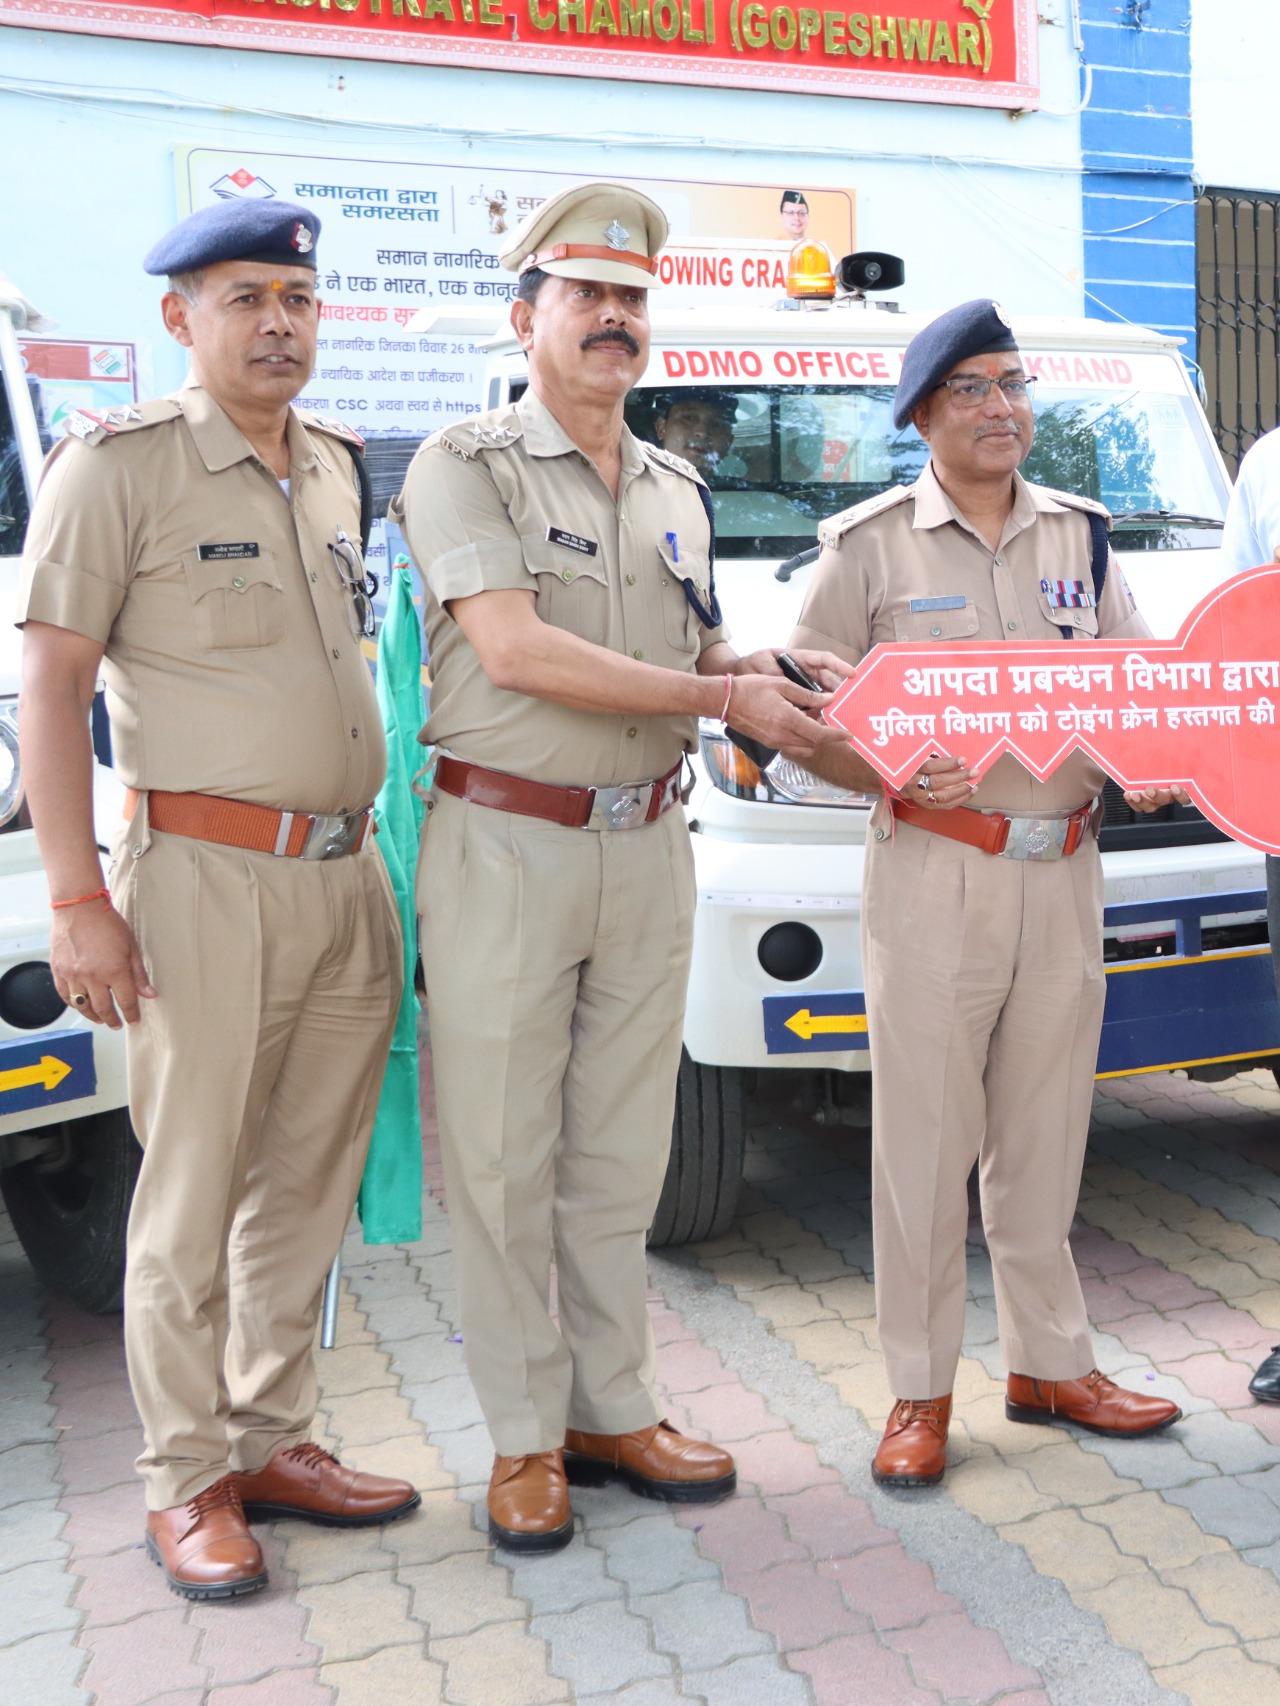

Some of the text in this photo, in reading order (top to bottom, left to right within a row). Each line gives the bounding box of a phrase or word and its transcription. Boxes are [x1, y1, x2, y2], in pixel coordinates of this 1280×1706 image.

[528, 0, 716, 44] CHAMOLI
[729, 0, 993, 74] (GOPESHWAR)
[294, 183, 438, 205] समानता द्वारा
[341, 204, 440, 222] समरसता
[376, 248, 500, 269] समान नागरिक
[325, 270, 341, 291] ने
[347, 276, 378, 292] एक
[439, 280, 468, 296] एक
[654, 255, 787, 288] OWING CRA
[331, 336, 376, 352] नागरिक
[379, 337, 416, 352] जिनका
[419, 338, 448, 354] विवाह
[451, 343, 465, 354] 26
[368, 366, 396, 382] आदेश
[400, 371, 414, 382] का
[662, 351, 763, 377] DDMO
[773, 351, 890, 378] OFFICE
[336, 399, 368, 410] CSC
[375, 400, 404, 411] अथवा
[446, 401, 482, 414] https
[902, 653, 1280, 696] आपदा प्रबन्धन विभाग द्वारा
[869, 707, 936, 747] पुलिस
[942, 705, 1011, 735] विभाग
[1017, 703, 1048, 733] को
[1055, 701, 1113, 734] टोइंग
[1119, 700, 1158, 730] क्रेन
[1164, 705, 1241, 729] हस्तगत
[1246, 697, 1275, 725] की
